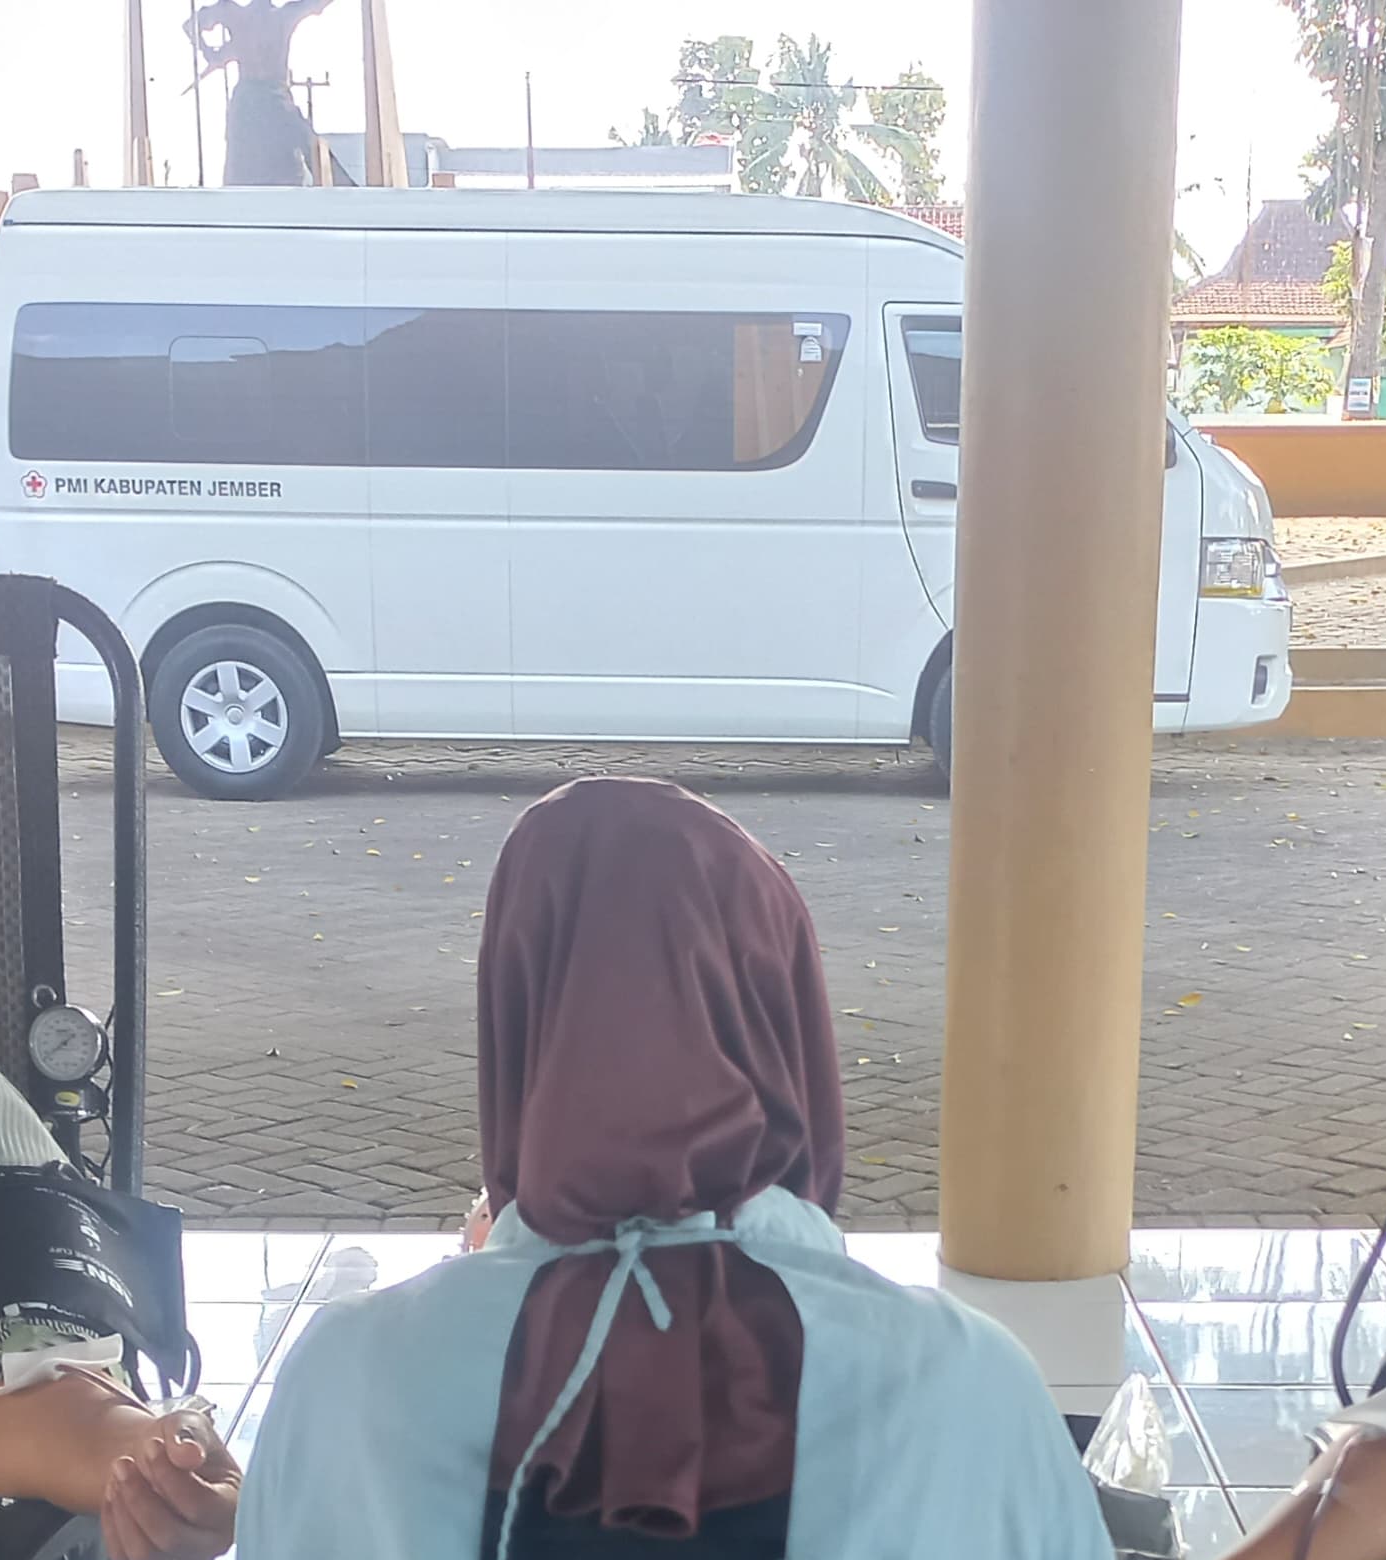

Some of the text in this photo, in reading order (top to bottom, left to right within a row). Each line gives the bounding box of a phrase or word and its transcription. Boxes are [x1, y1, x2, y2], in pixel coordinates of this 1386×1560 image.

[55, 477, 282, 498] PMI KABUPATEN JEMBER
